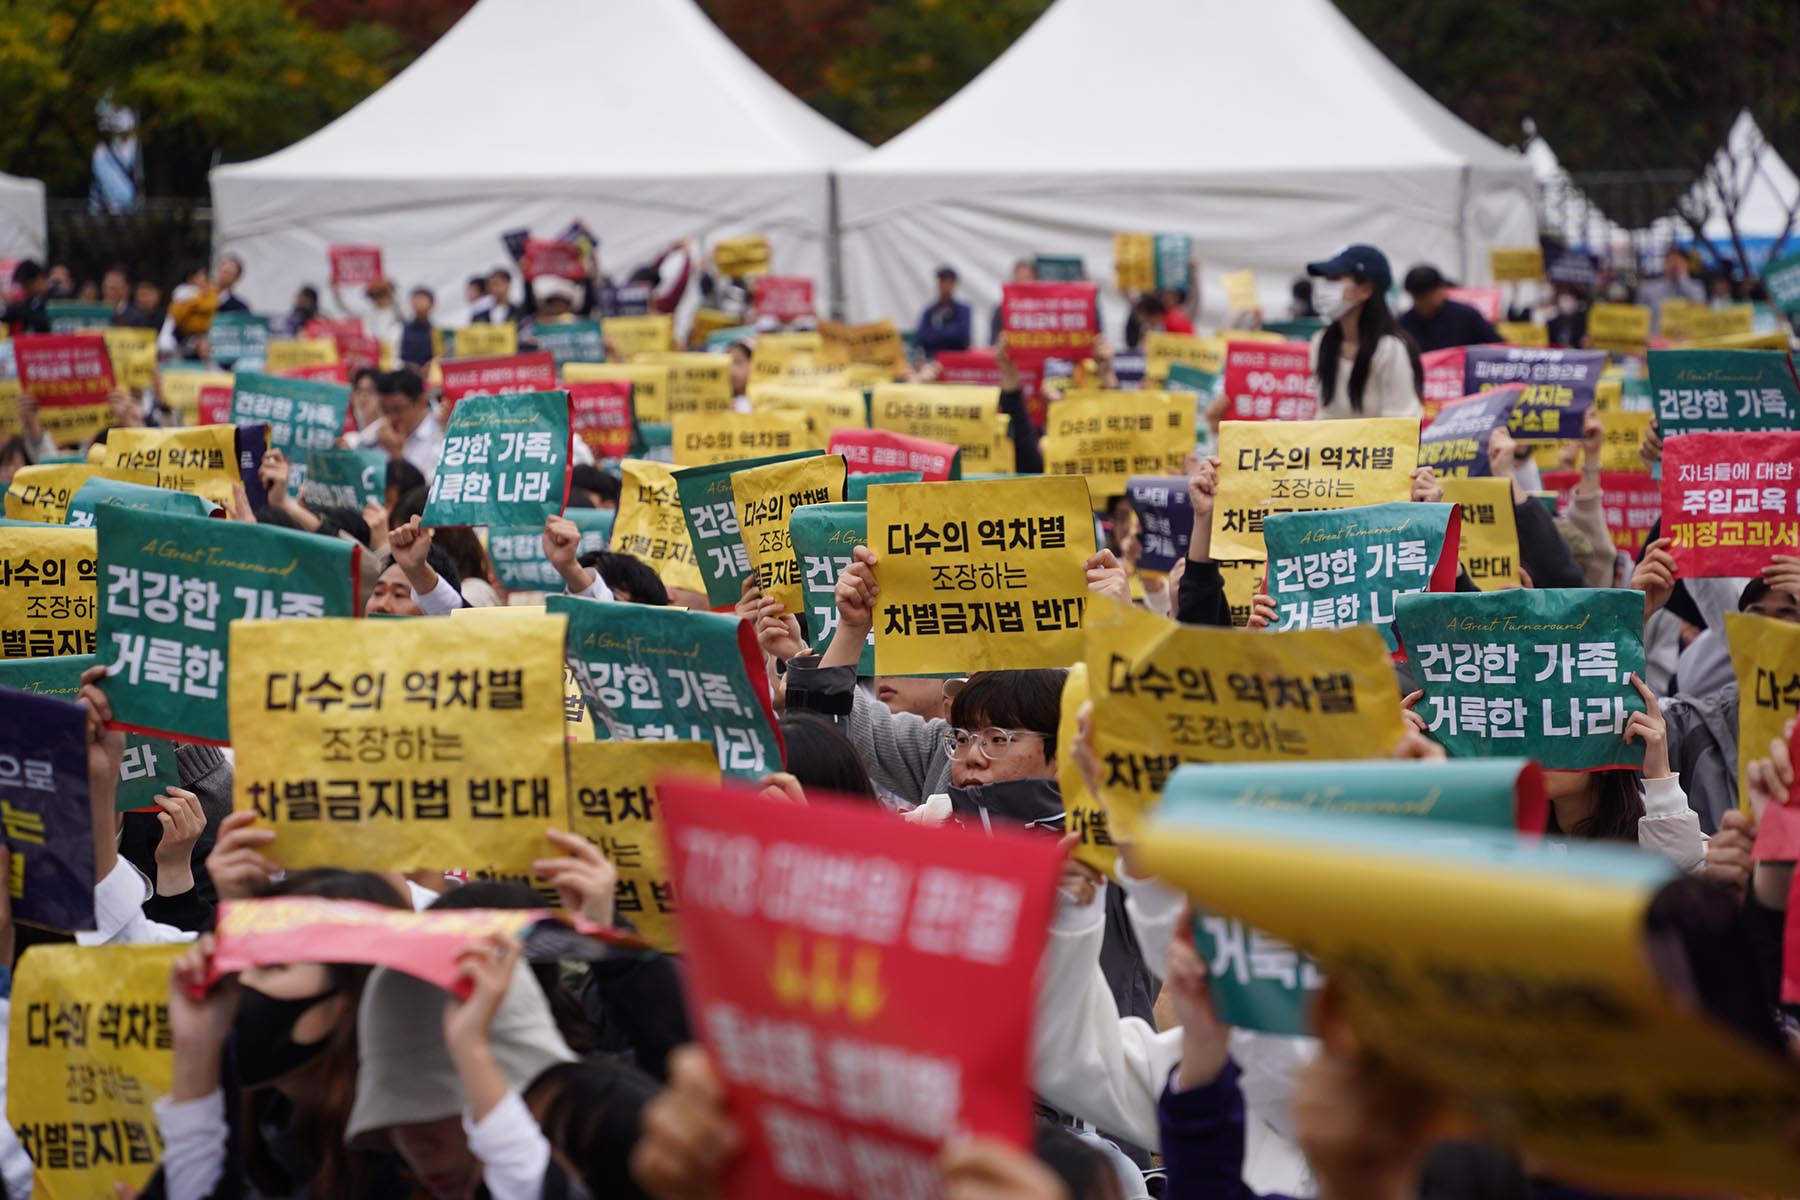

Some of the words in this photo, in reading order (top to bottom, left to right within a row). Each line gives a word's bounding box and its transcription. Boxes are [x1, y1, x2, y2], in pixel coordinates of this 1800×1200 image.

[1659, 389, 1728, 420] 건강한
[1736, 388, 1795, 420] 가족,
[168, 448, 225, 469] 역차별
[437, 432, 491, 465] 강한
[497, 432, 557, 465] 가족,
[1238, 447, 1310, 472] 다수의
[1320, 446, 1395, 470] 역차별
[429, 471, 492, 504] 룩한
[497, 471, 551, 503] 나라
[1271, 478, 1355, 499] 조장하는
[1678, 463, 1750, 482] 자녀들에
[1756, 462, 1793, 481] 대한
[21, 486, 70, 510] 다수의
[744, 495, 783, 527] 다수의
[1683, 488, 1787, 515] 주입교육
[887, 521, 969, 556] 다수의
[977, 515, 1066, 552] 역차별
[1313, 527, 1345, 543] Great
[1670, 521, 1799, 548] 개정교과서
[930, 562, 1028, 591] 조장하는
[1276, 547, 1357, 593] 건강한
[1366, 540, 1434, 578] 가족,
[1470, 557, 1511, 578] 반대
[107, 564, 221, 632] 건강한
[1278, 592, 1360, 632] 거룩한
[1371, 585, 1427, 624] 나
[884, 600, 1024, 636] 차별금지법
[1032, 597, 1086, 631] 반대
[1447, 620, 1458, 631] A
[1460, 616, 1499, 632] Great
[1502, 614, 1591, 632] Turnaround
[106, 631, 224, 699] 거룩한
[1417, 643, 1520, 684] 건강한
[1534, 642, 1632, 686] 가족,
[266, 671, 384, 713] 다수의
[403, 668, 524, 711] 역차별
[668, 668, 754, 719] 가족,
[1108, 653, 1218, 705] 다수의
[1227, 671, 1359, 714] 역차별
[1167, 713, 1309, 755] 조장하는
[1428, 696, 1528, 739] 거룩한
[1542, 697, 1628, 737] 나라
[321, 724, 463, 764] 조장하는
[248, 776, 449, 822] 차별금지법
[468, 777, 550, 819] 반대
[27, 1002, 90, 1047] 다수의
